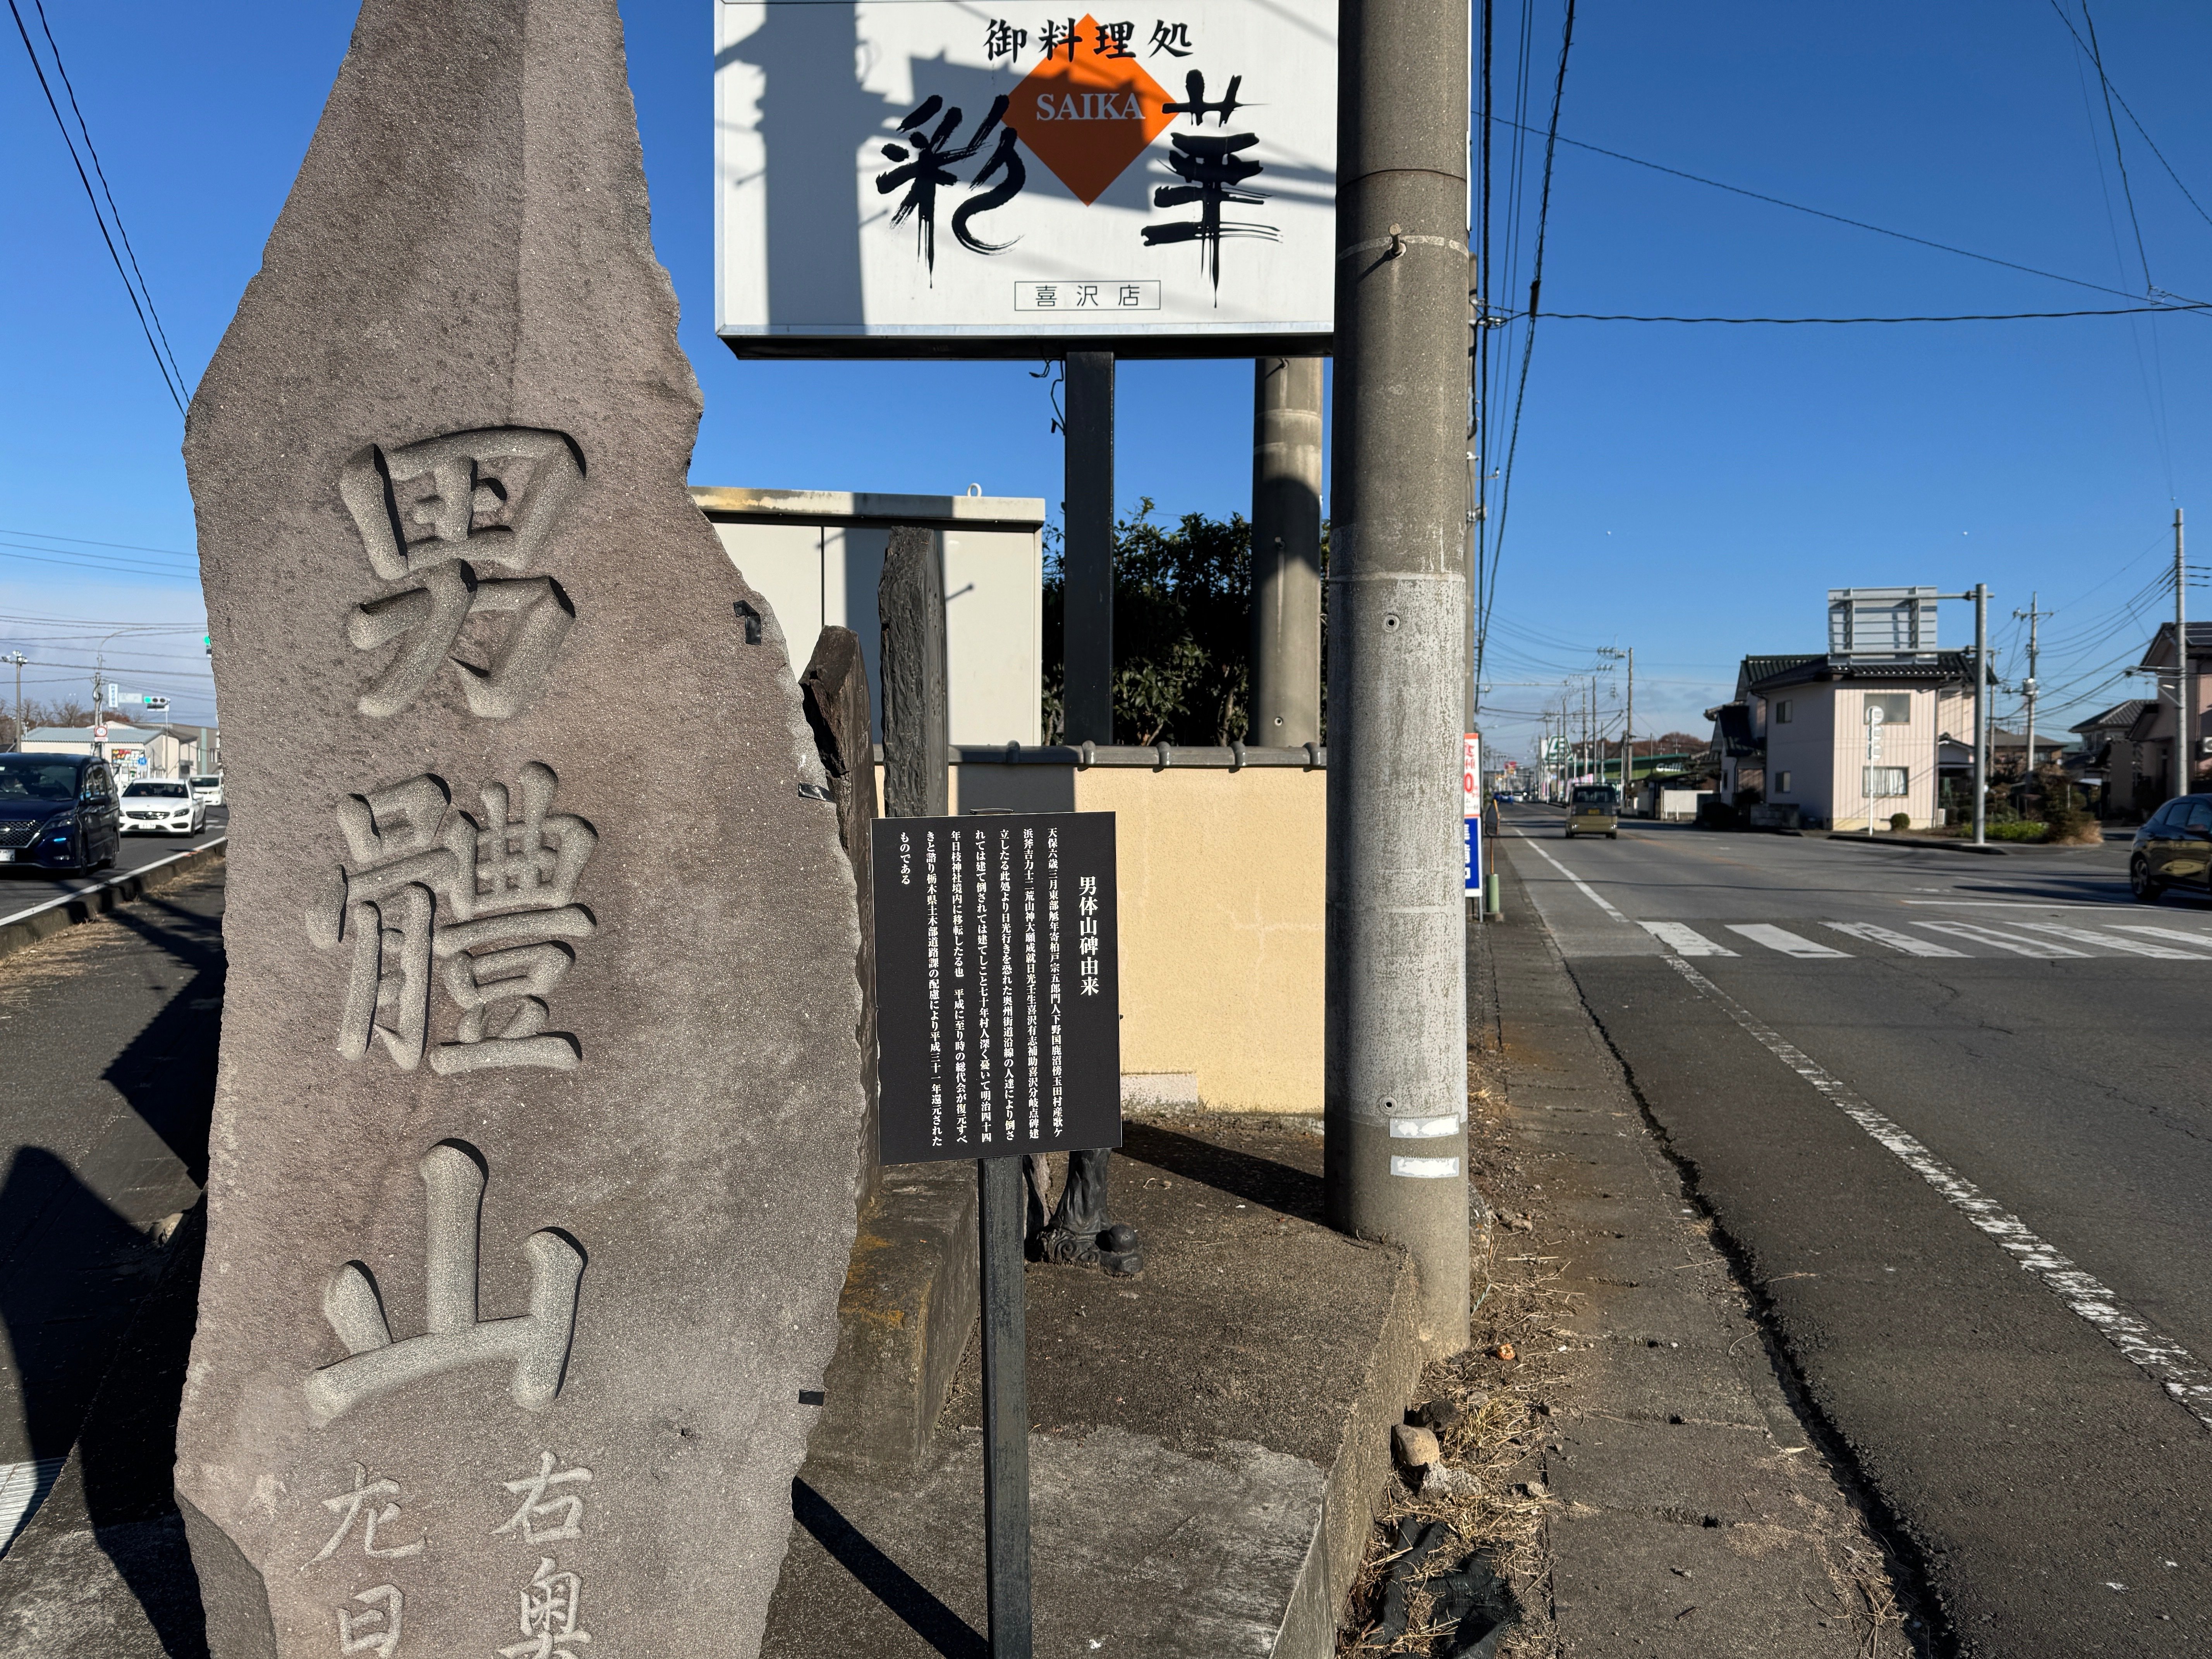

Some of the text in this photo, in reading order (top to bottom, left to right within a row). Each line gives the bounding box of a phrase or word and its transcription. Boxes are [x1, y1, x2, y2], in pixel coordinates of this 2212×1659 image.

[983, 17, 1193, 63] 御料理処
[1036, 93, 1145, 121] SAIKA
[876, 69, 1283, 308] 彩華
[1036, 285, 1140, 306] 喜沢店
[900, 832, 911, 885] ものである
[1079, 876, 1099, 996] 男体山碑由来
